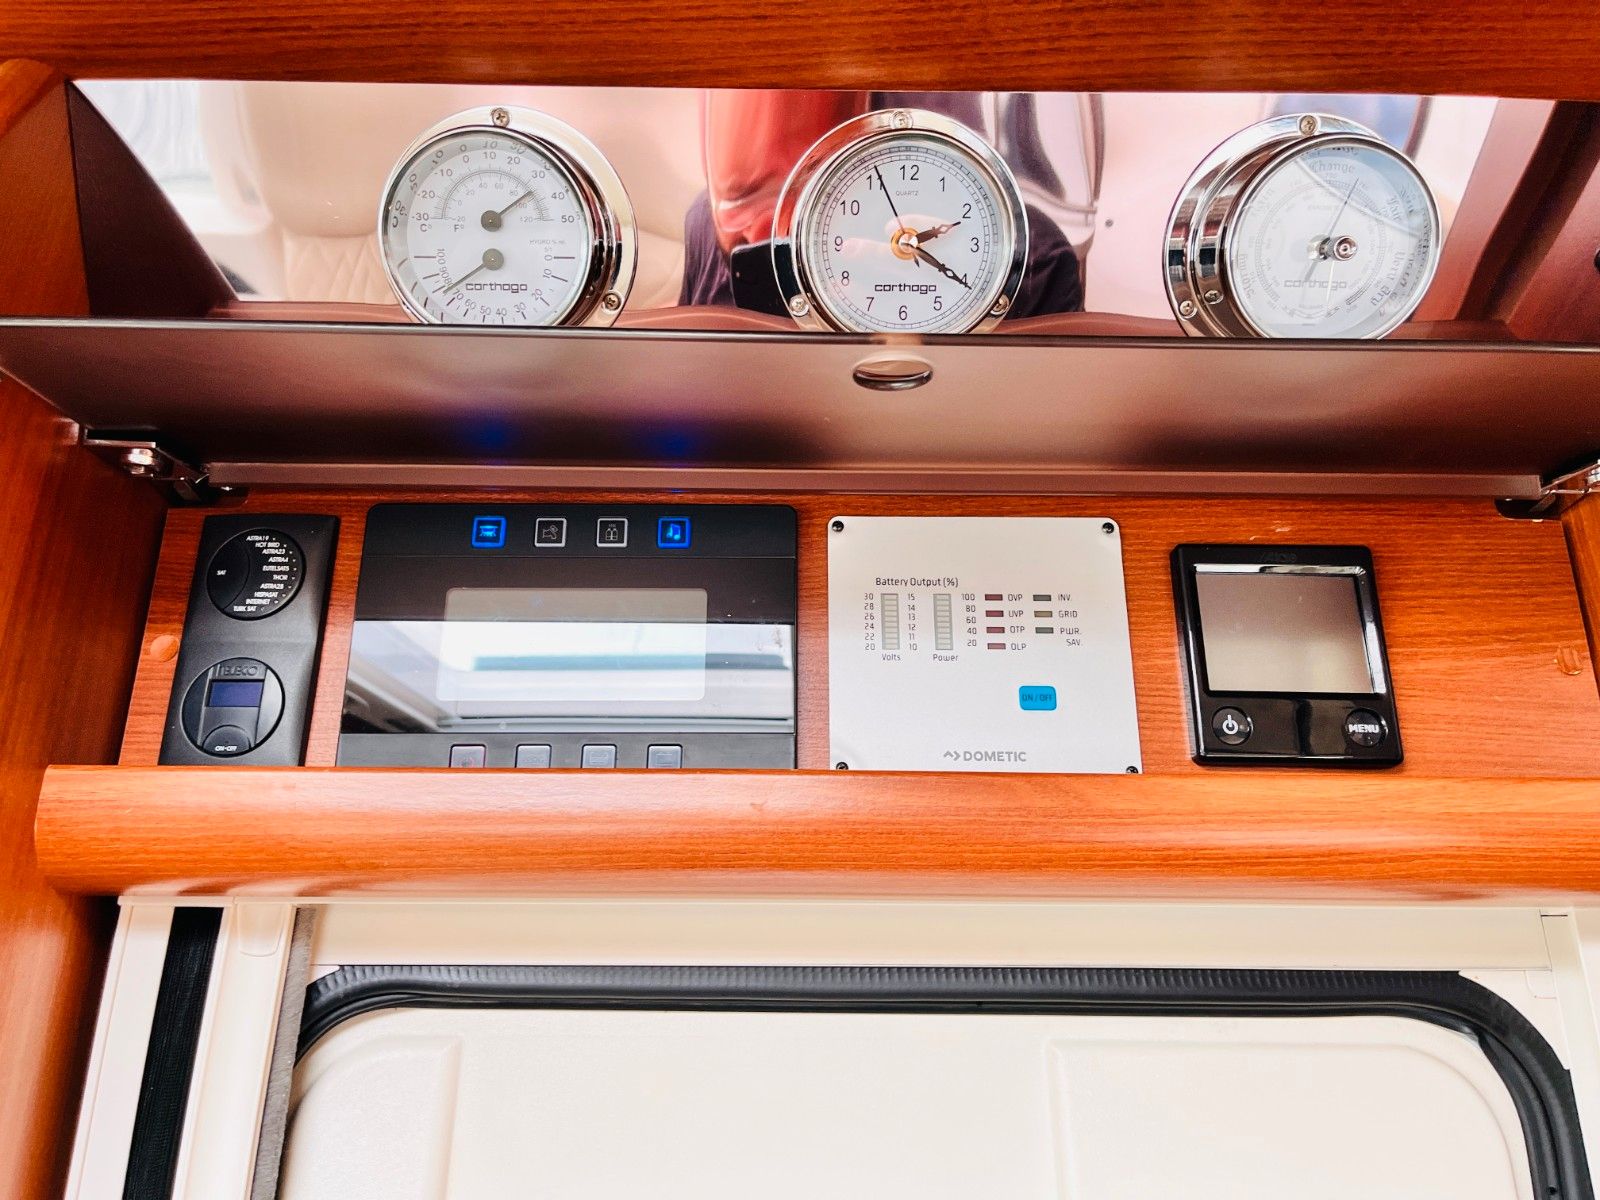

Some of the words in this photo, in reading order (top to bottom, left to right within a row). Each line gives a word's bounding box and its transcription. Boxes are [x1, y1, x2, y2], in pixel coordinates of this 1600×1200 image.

[462, 155, 470, 163] 0
[484, 152, 497, 160] 10
[507, 156, 521, 165] 20
[434, 168, 453, 178] -10
[531, 170, 546, 179] 30
[900, 164, 920, 180] 12
[866, 175, 884, 190] 11
[940, 176, 946, 192] 1
[416, 190, 436, 199] -20
[551, 192, 565, 200] 40
[840, 200, 860, 216] 10
[962, 203, 972, 219] 2
[412, 212, 430, 221] -30
[560, 215, 575, 223] 50
[834, 236, 843, 252] 9
[970, 237, 980, 253] 3
[543, 268, 552, 279] 10
[840, 270, 850, 286] 8
[465, 282, 528, 294] carthago
[874, 283, 937, 294] carthago
[1284, 278, 1347, 291] carthago
[532, 288, 543, 301] 20
[465, 298, 477, 310] 60
[514, 302, 526, 314] 30
[866, 296, 875, 312] 7
[933, 296, 943, 311] 5
[480, 306, 491, 316] 50
[495, 307, 508, 316] 40
[898, 305, 908, 321] 6
[875, 577, 908, 587] Battery
[909, 577, 942, 587] Output
[942, 577, 959, 588] (%)
[960, 593, 976, 601] 100
[864, 602, 874, 610] 28
[966, 616, 976, 624] 60
[882, 653, 901, 661] Volts
[932, 654, 958, 662] Power
[1348, 723, 1380, 735] MENU
[963, 750, 1027, 762] DOMETIC
